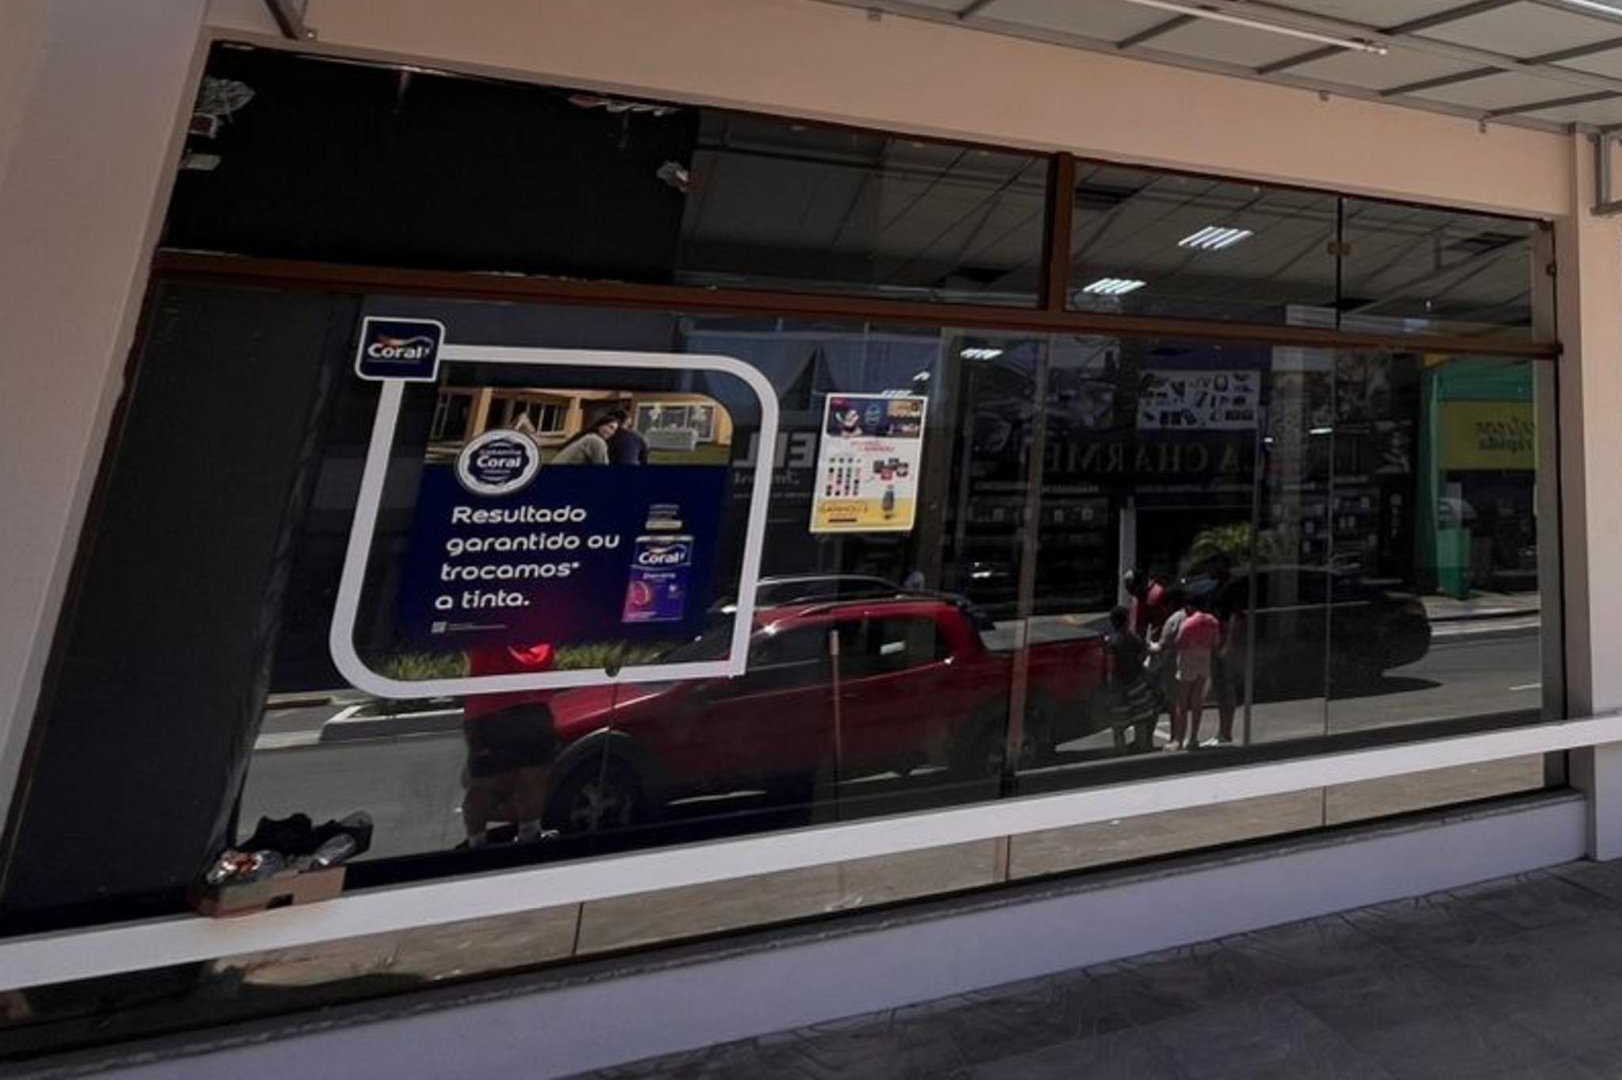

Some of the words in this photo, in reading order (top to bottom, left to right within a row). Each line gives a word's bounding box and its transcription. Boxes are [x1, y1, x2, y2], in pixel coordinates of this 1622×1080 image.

[367, 342, 423, 360] Coral
[476, 455, 522, 468] Coral
[451, 505, 587, 525] Resultado
[446, 532, 580, 556] garantido
[587, 534, 620, 549] ou
[638, 551, 681, 566] Coral
[434, 595, 453, 610] a
[461, 589, 530, 609] tinta.
